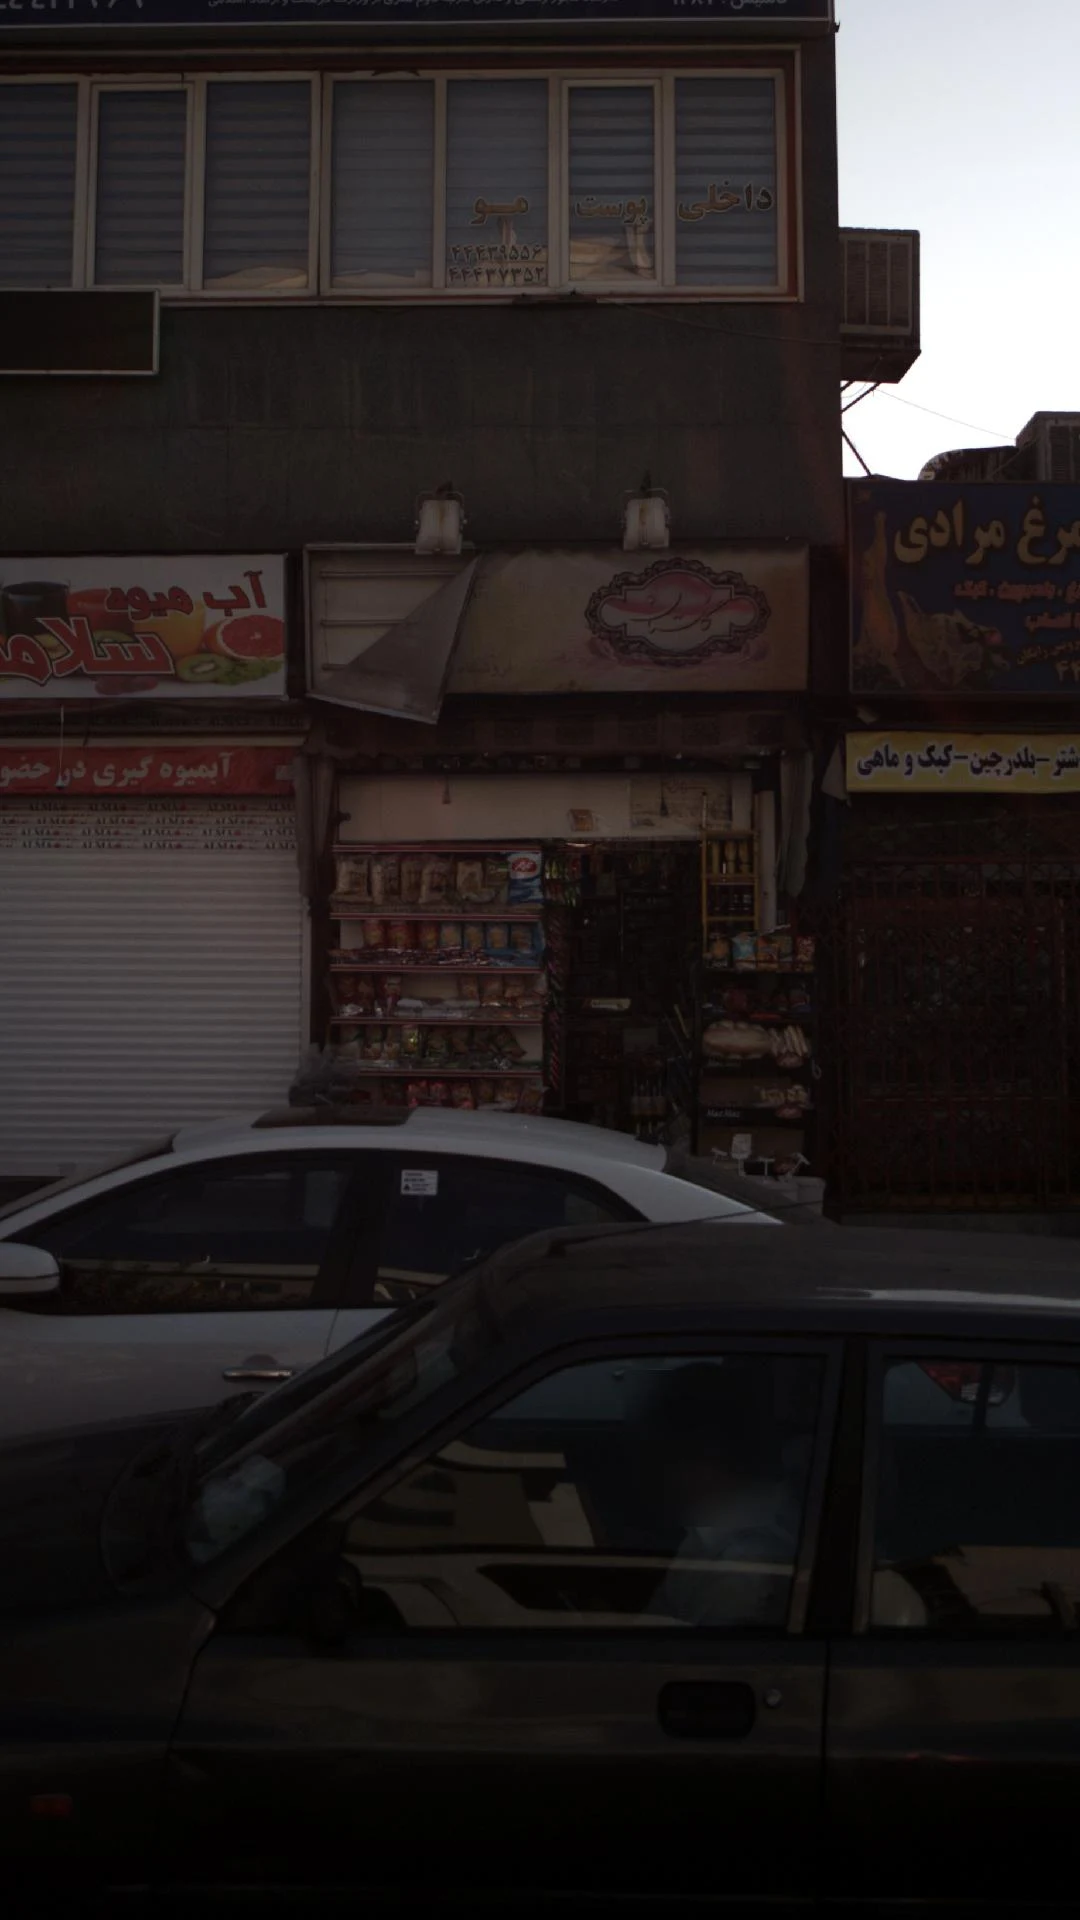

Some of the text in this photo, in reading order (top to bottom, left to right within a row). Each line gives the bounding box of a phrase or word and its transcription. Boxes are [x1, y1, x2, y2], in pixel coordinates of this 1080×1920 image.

[575, 195, 651, 224] پوست
[678, 180, 773, 221] داخلی
[894, 496, 1005, 565] مرادی
[106, 570, 267, 621] آب میوه
[0, 615, 175, 687] سلام
[0, 755, 52, 787] حضو
[92, 757, 154, 787] گیری
[158, 752, 235, 786] آبمیوه
[857, 744, 899, 776] ماهی
